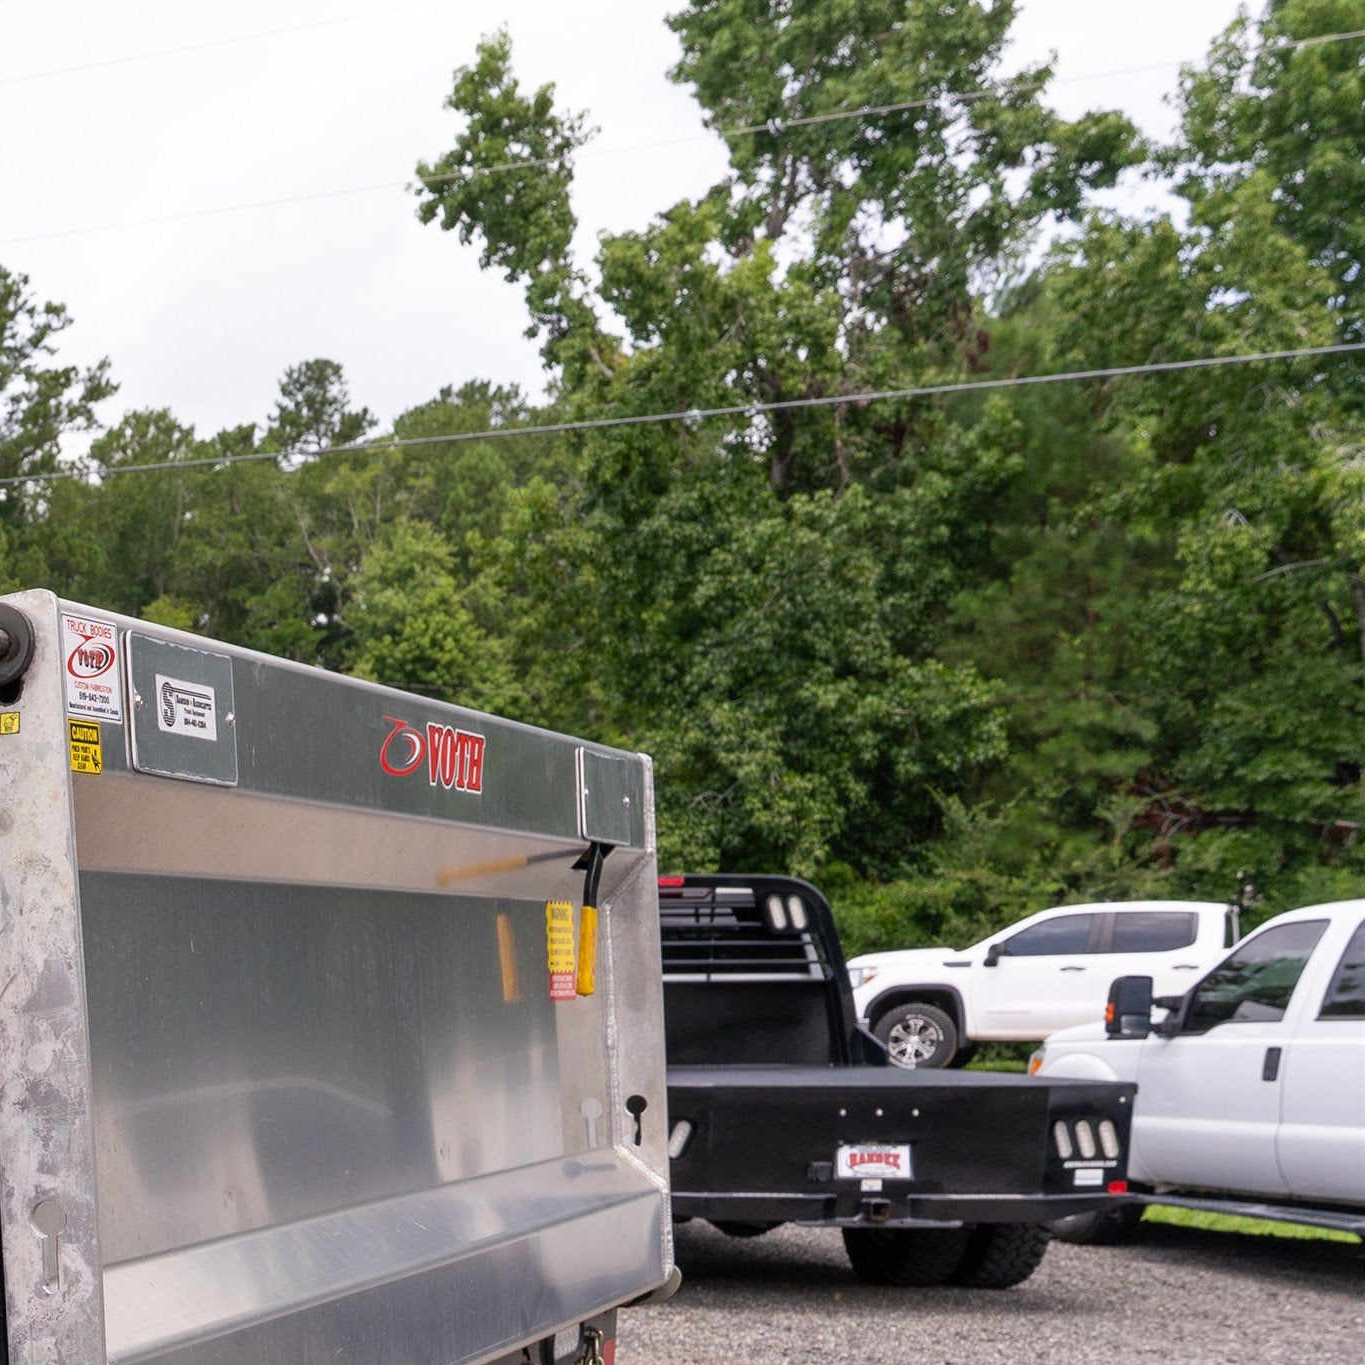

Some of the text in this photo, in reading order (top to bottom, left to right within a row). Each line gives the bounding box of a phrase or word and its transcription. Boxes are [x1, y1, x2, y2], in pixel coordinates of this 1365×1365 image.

[66, 618, 112, 640] TRUCK BODIES
[72, 725, 98, 742] CAUTION
[427, 721, 486, 795] VOTH
